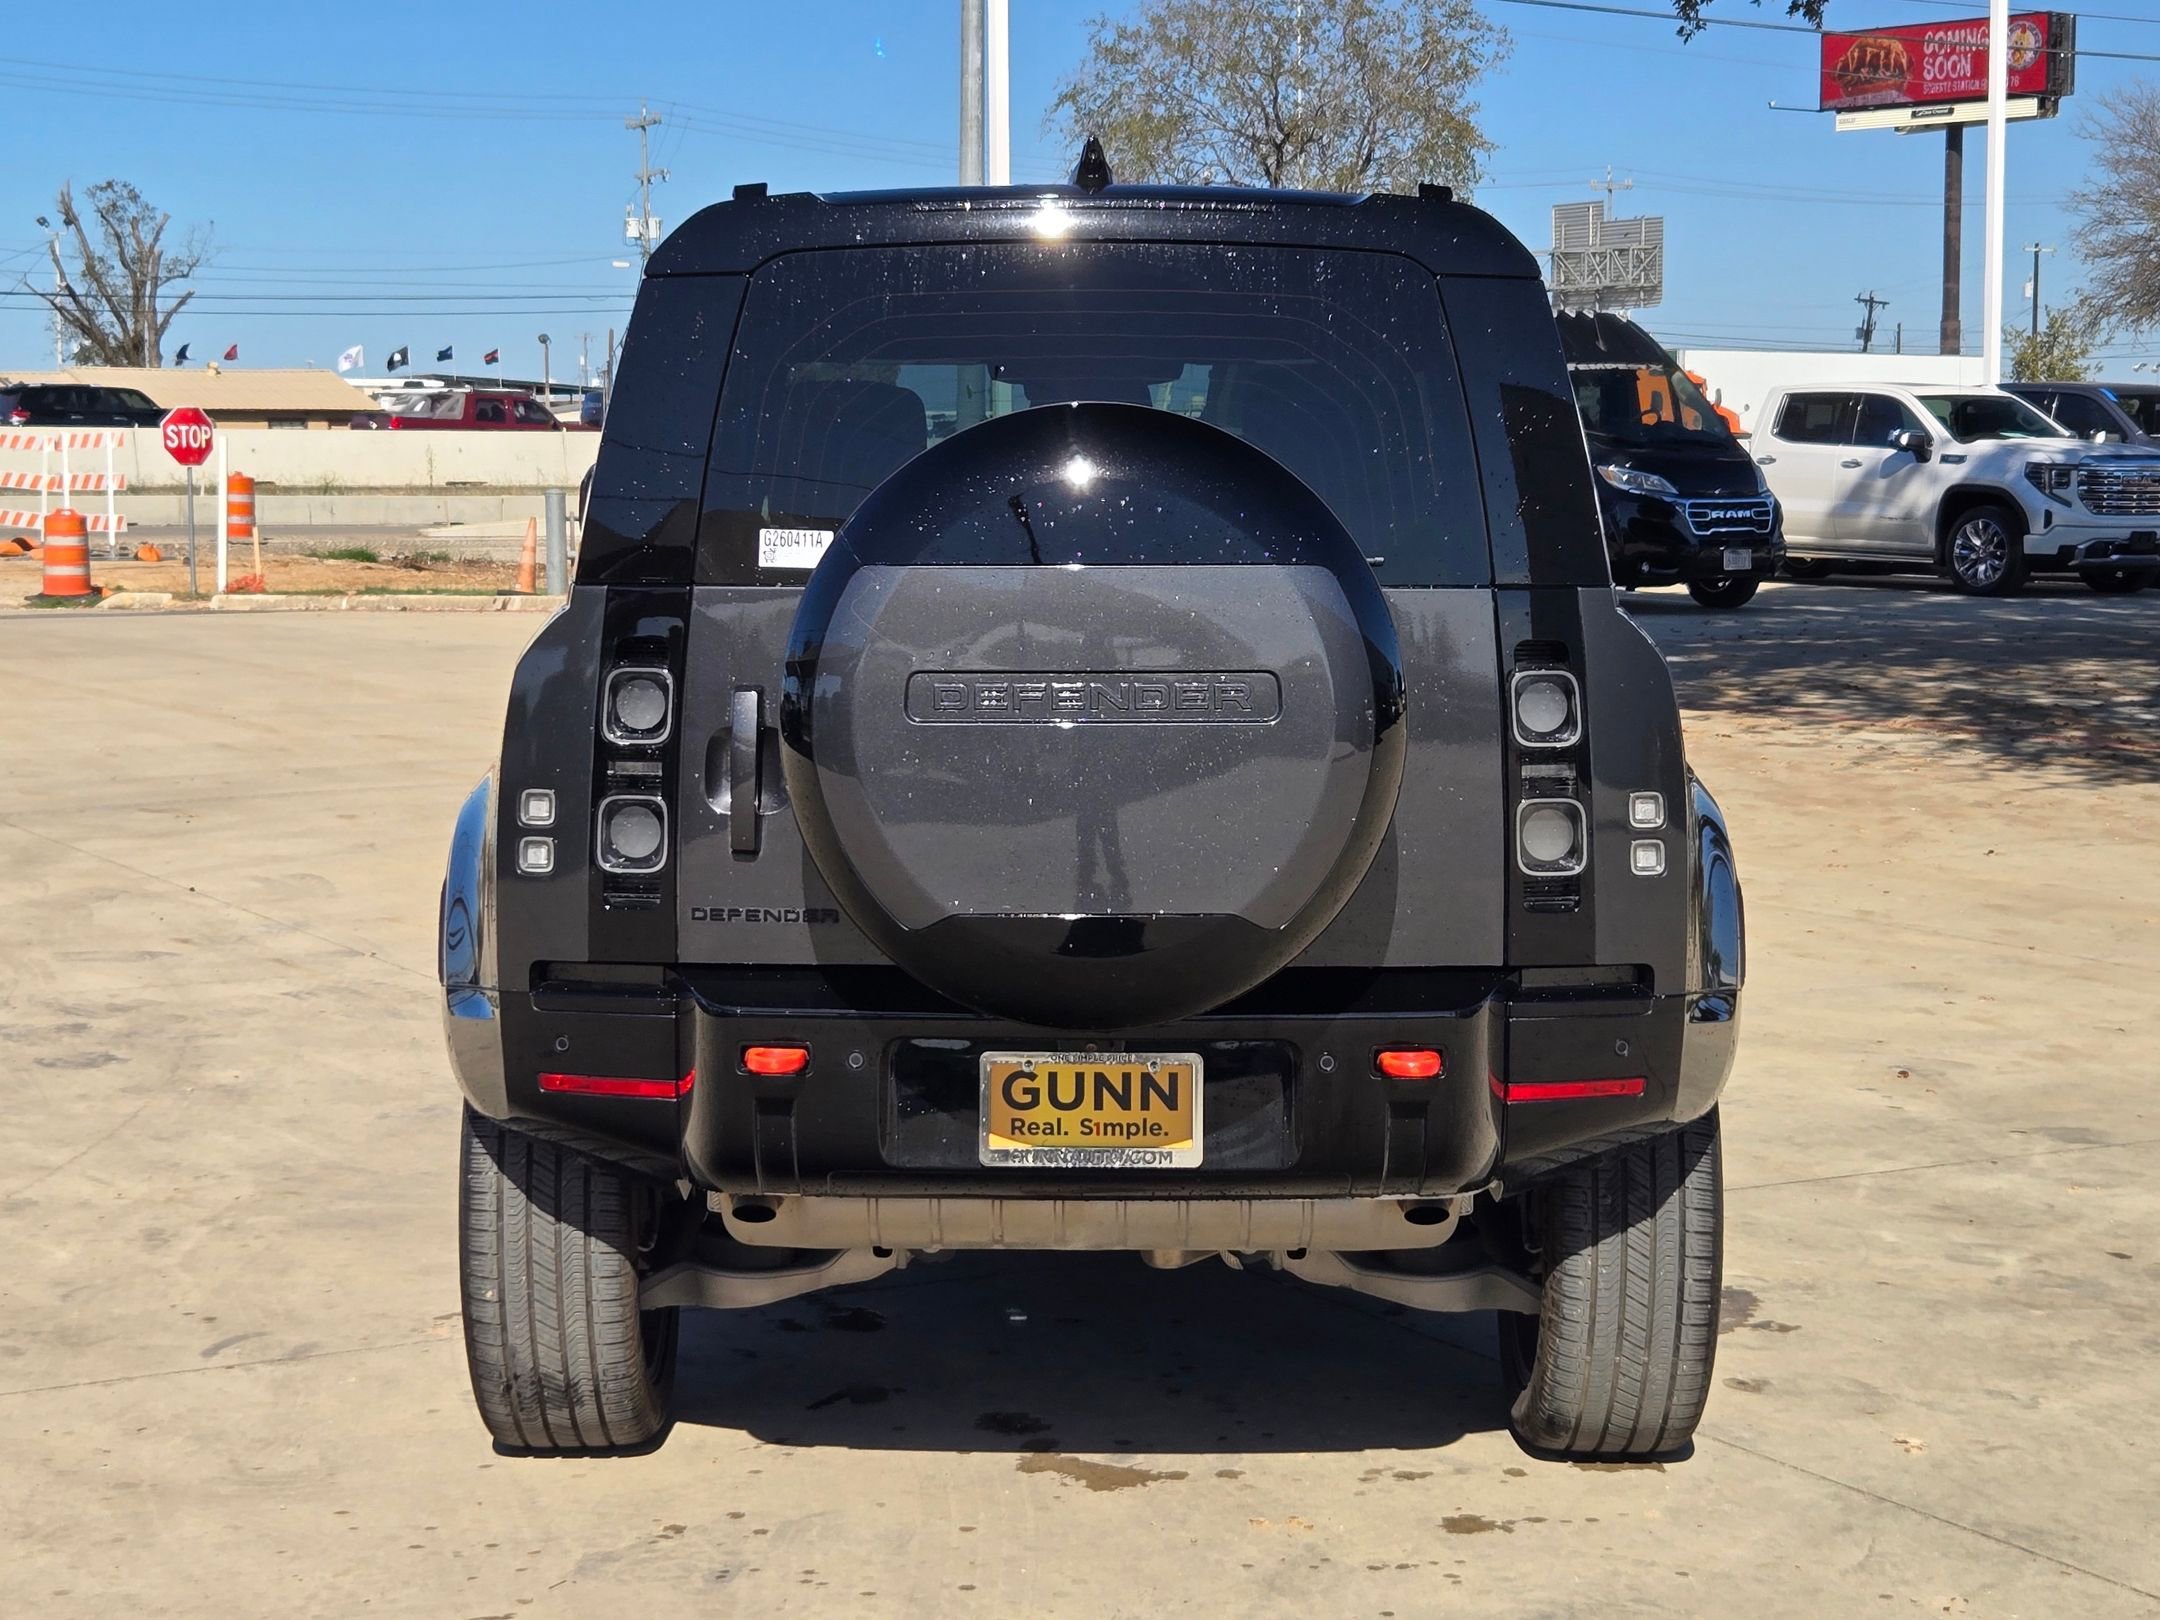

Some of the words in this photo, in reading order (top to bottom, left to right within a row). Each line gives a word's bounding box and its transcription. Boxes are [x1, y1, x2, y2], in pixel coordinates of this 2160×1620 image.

[1923, 26, 1989, 54] COMING
[1923, 53, 1971, 80] SOON
[166, 424, 211, 449] STOP
[1711, 510, 1750, 518] RAM
[764, 530, 823, 548] G260411A
[932, 681, 1253, 712] DEFENDER
[691, 906, 840, 923] DEFENDER
[1051, 1053, 1070, 1062] ONE
[1072, 1053, 1104, 1062] SIMPLE
[1106, 1053, 1135, 1062] PRICE
[1002, 1070, 1179, 1111] GUNN
[1011, 1117, 1068, 1136] Real.
